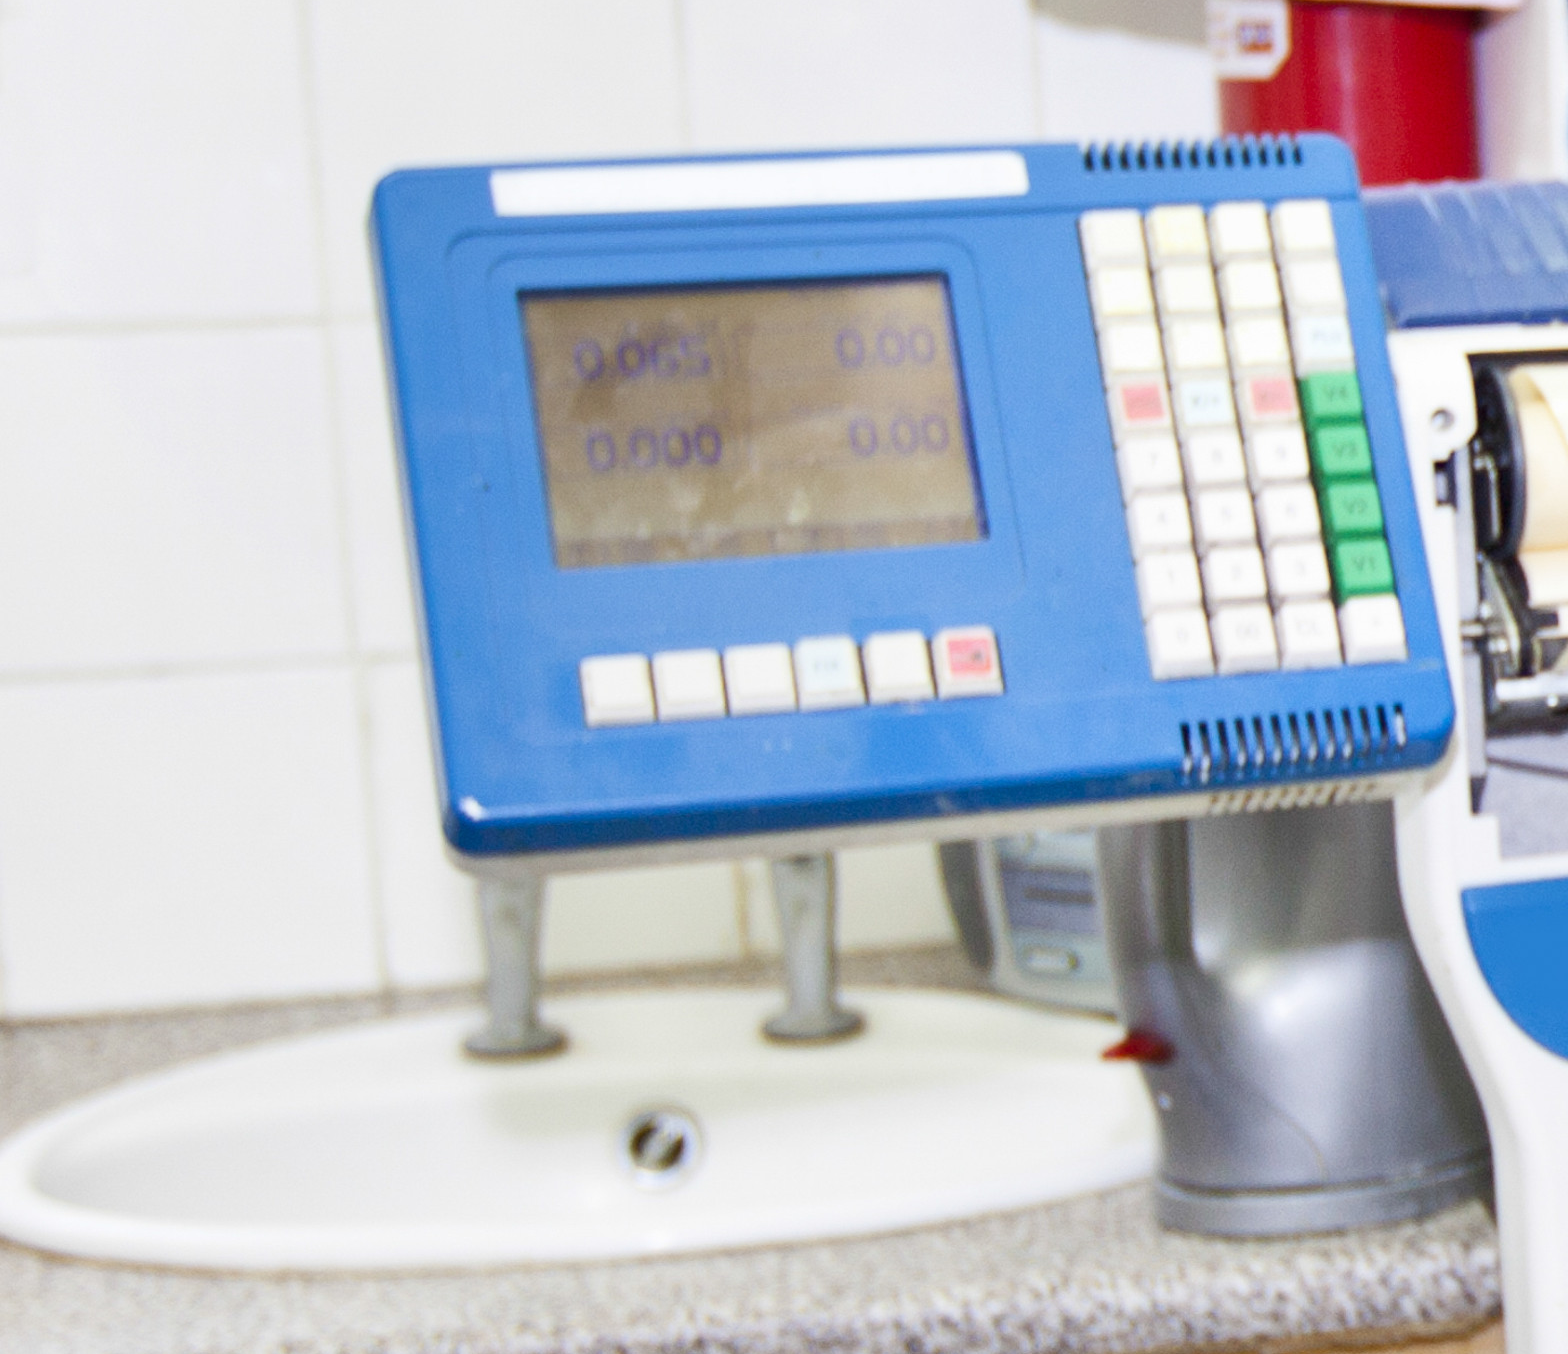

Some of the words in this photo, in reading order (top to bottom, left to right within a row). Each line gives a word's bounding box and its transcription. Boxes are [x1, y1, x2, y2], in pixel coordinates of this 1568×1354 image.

[834, 324, 936, 368] 0.00
[586, 424, 724, 472] 0.000
[848, 414, 949, 457] 0.00
[1352, 555, 1376, 571] V1
